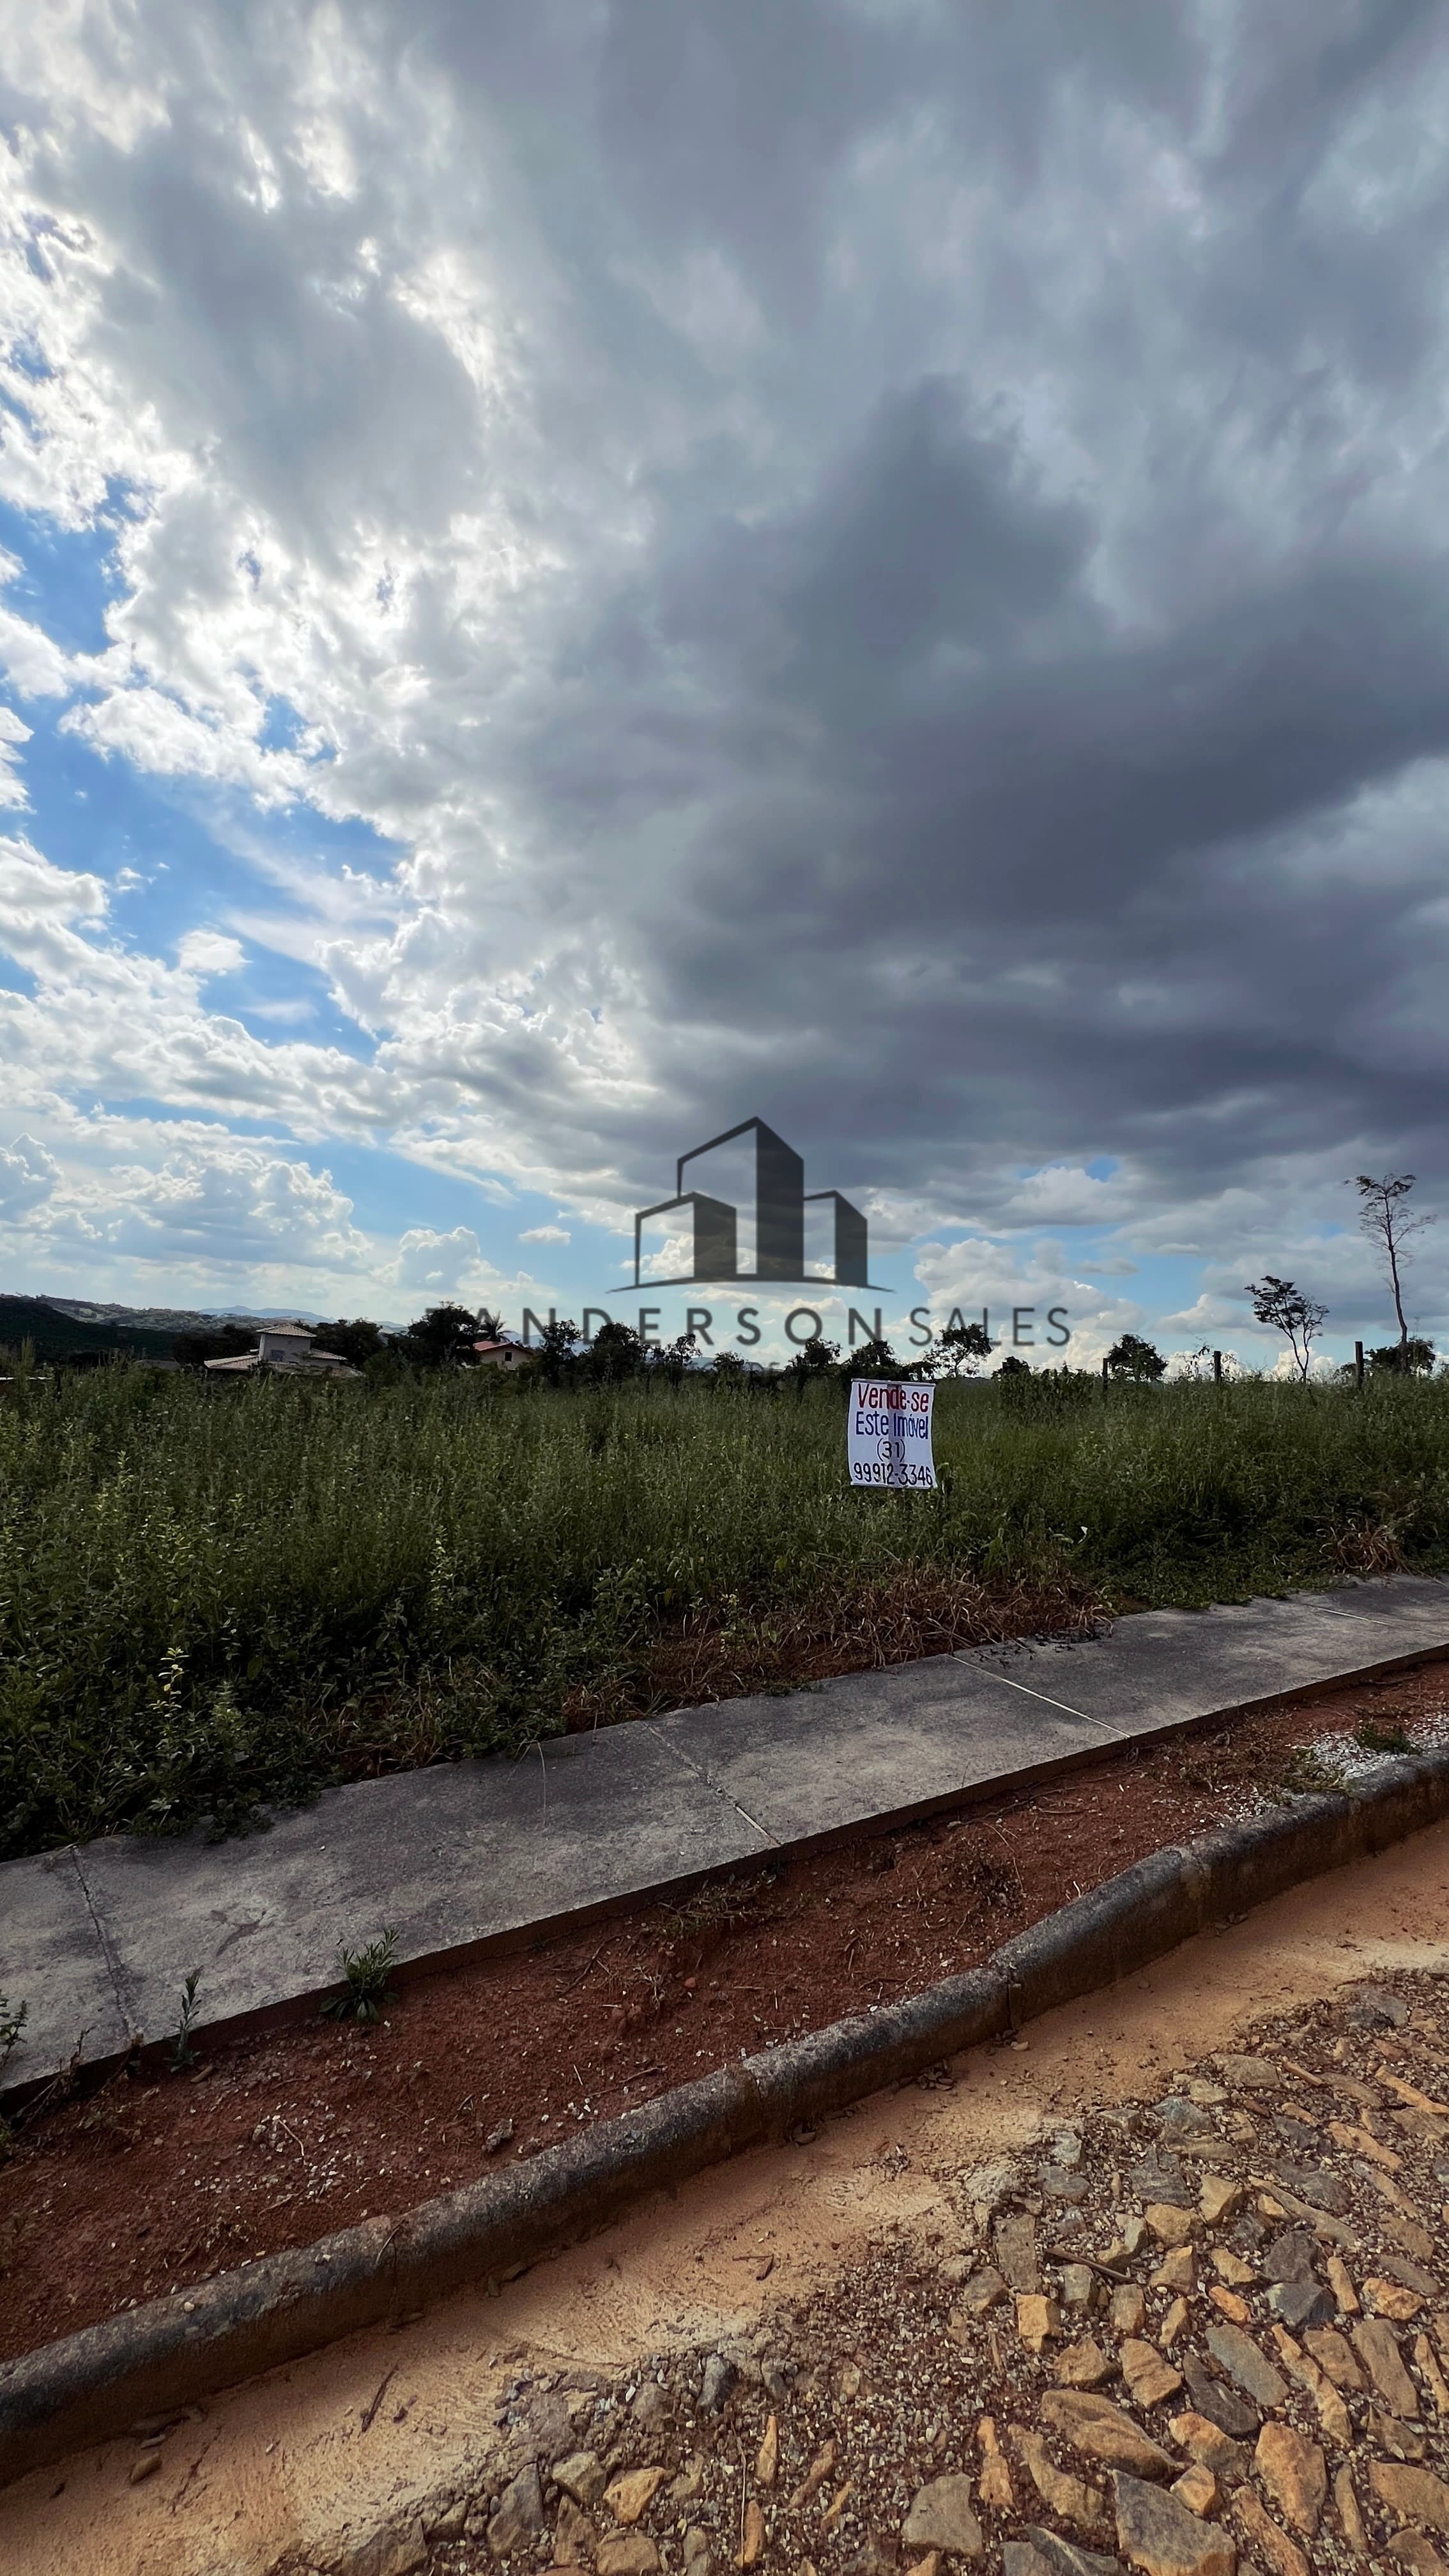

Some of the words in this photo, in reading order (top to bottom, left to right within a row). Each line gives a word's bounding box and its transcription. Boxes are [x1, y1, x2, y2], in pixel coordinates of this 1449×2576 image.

[858, 1383, 930, 1413] Vende-se
[855, 1411, 889, 1436] Este
[894, 1413, 929, 1439] Imóvel
[877, 1438, 906, 1462] (31)
[853, 1462, 933, 1485] 99912-3346
